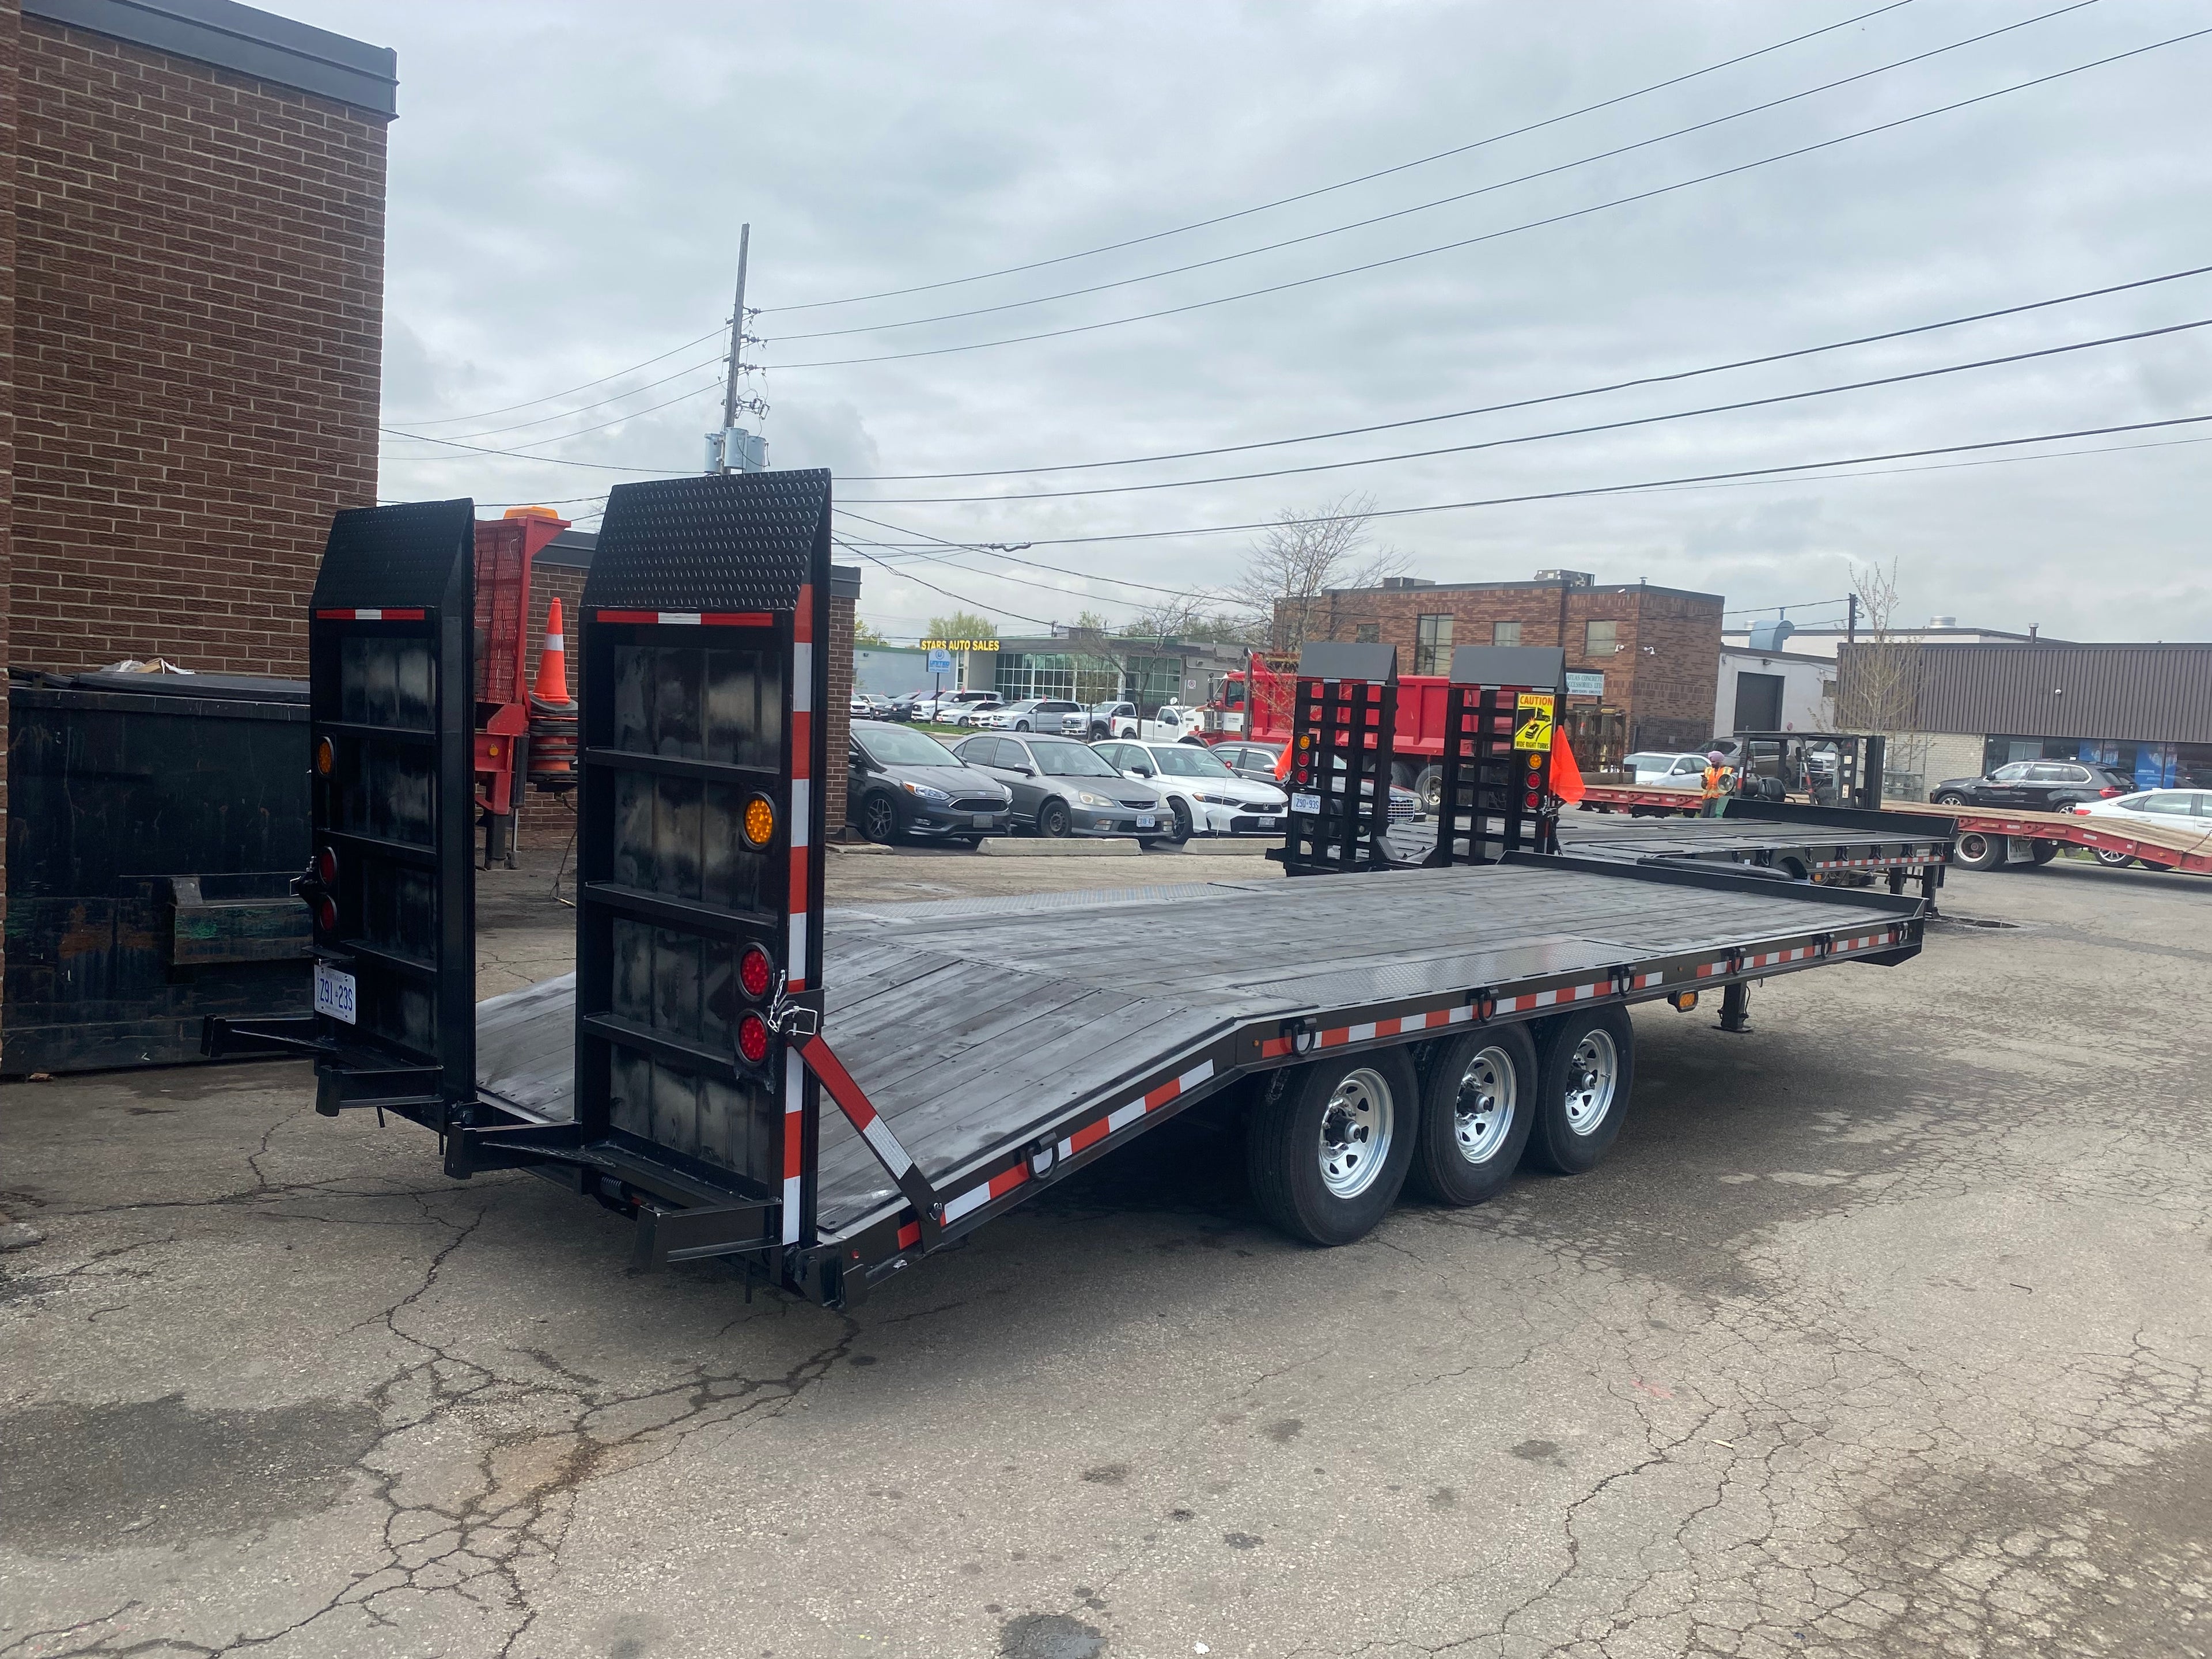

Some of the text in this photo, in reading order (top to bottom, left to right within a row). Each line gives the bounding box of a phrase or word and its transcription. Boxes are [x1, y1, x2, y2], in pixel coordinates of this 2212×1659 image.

[921, 640, 1000, 651] STARS AUTO SALES
[1520, 695, 1553, 706] CAUTION
